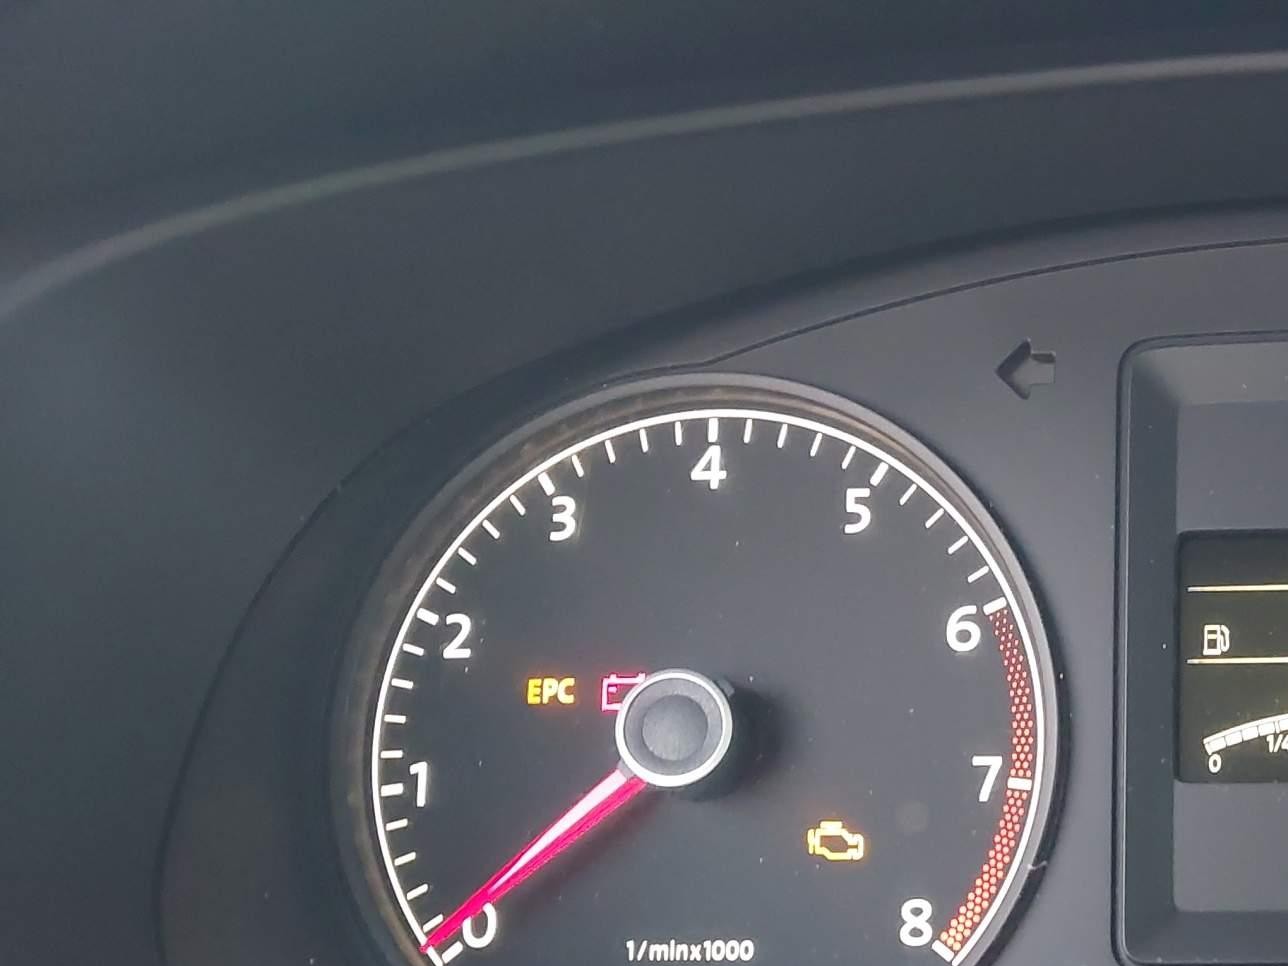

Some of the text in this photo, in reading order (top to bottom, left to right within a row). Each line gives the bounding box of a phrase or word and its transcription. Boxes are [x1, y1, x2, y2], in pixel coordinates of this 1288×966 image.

[690, 444, 728, 490] 4
[549, 495, 577, 541] 3
[844, 487, 872, 534] 5
[442, 613, 472, 659] 2
[945, 604, 981, 653] 6
[526, 677, 577, 705] EPC
[409, 761, 428, 808] 1
[971, 755, 1003, 803] 7
[1208, 753, 1222, 773] 0
[463, 903, 497, 949] 0
[899, 898, 934, 948] 8
